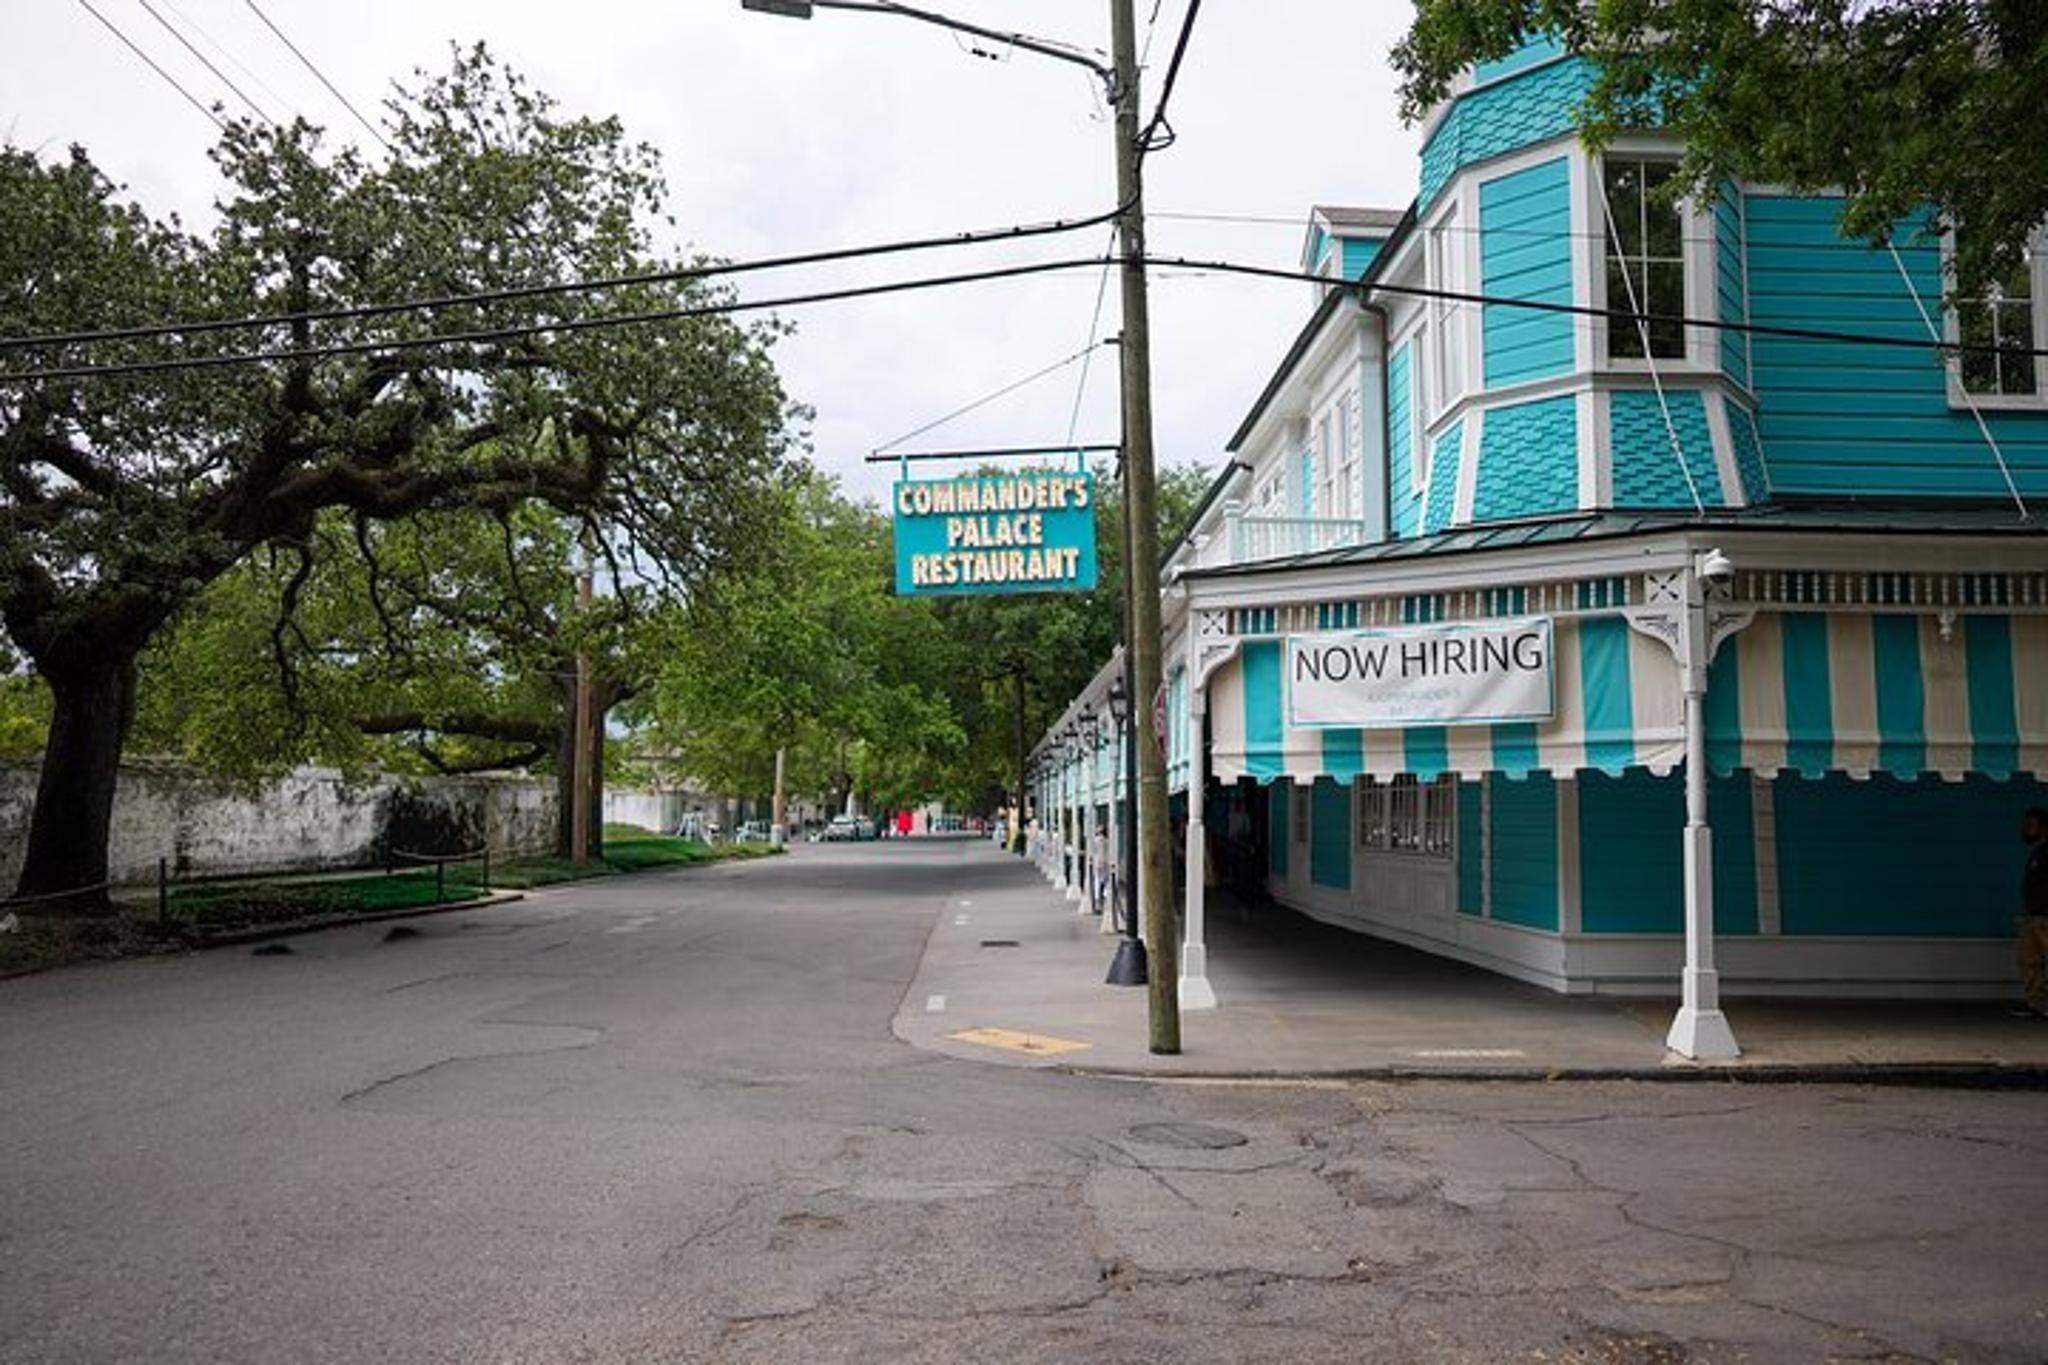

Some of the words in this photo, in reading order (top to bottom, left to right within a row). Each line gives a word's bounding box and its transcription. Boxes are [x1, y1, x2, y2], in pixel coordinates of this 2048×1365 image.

[898, 477, 1088, 515] COMMANDER'S
[947, 514, 1043, 547] PALACE
[911, 547, 1079, 585] RESTAURANT
[1296, 644, 1389, 682] NOW
[1401, 633, 1542, 678] HIRING
